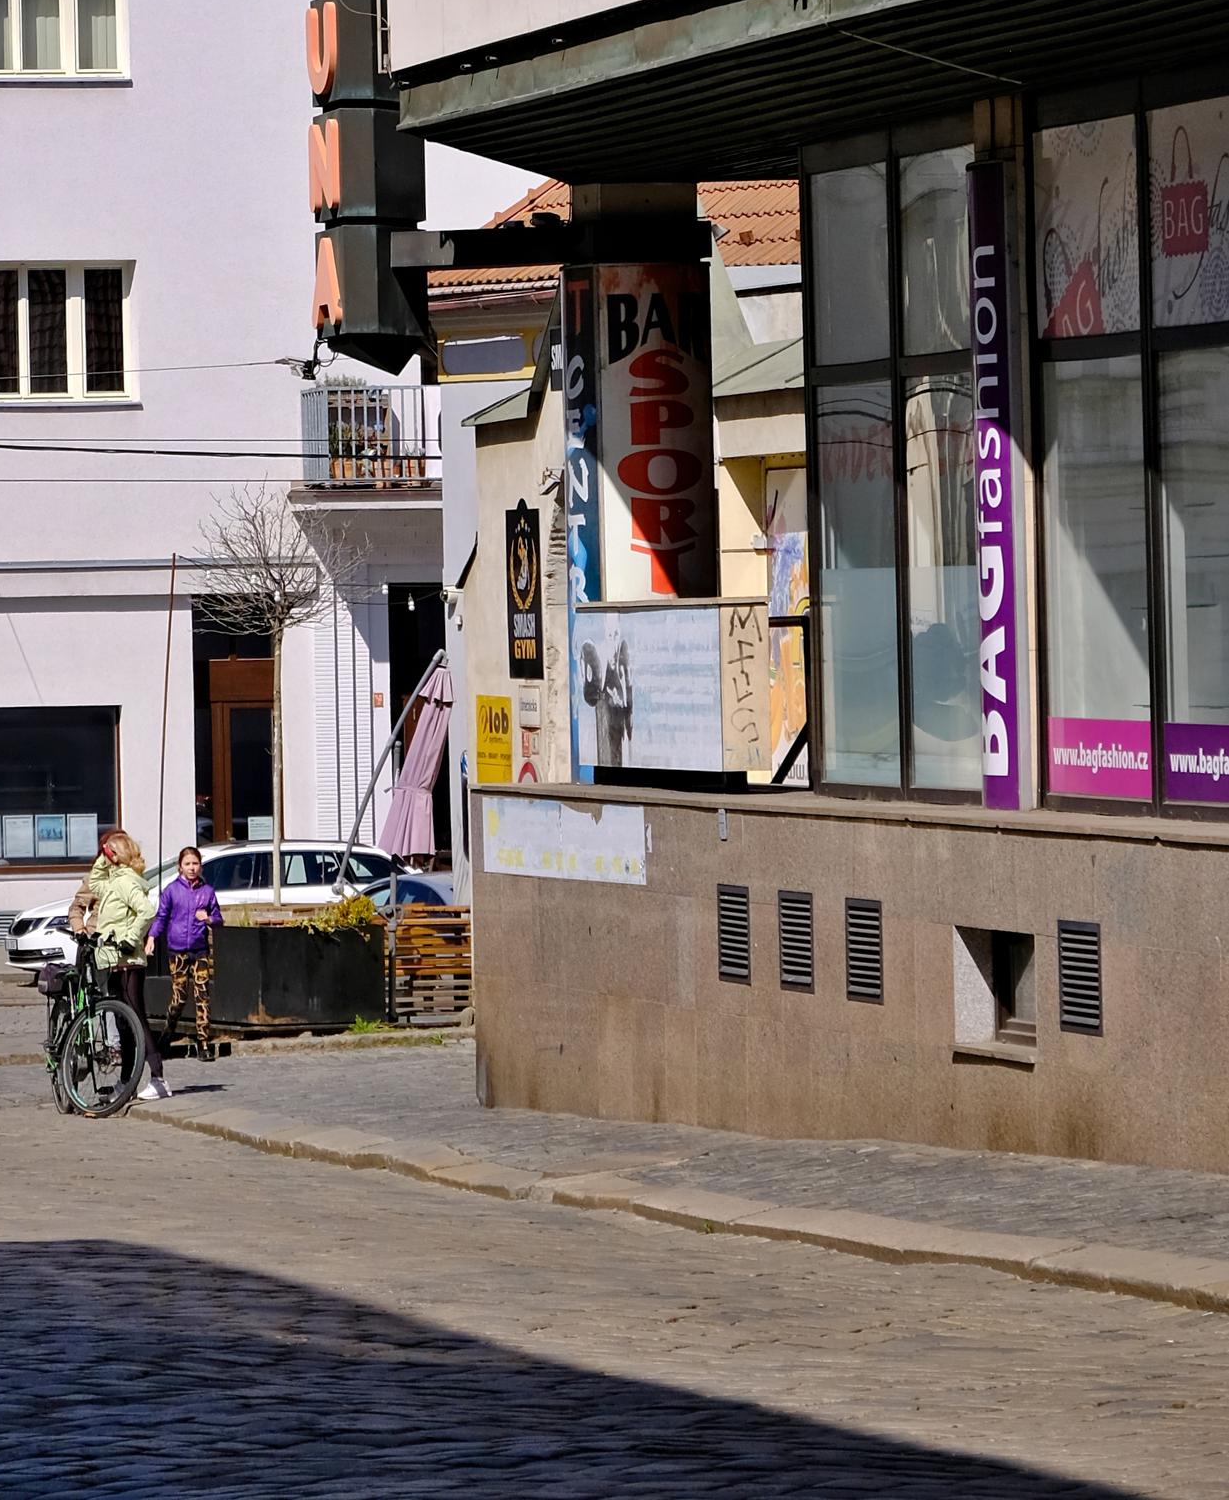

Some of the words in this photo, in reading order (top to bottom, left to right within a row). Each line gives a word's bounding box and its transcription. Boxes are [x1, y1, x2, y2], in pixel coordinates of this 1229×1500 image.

[1163, 195, 1204, 240] BAG
[618, 348, 703, 595] SPORT
[974, 244, 1009, 777] BAGfashion
[513, 612, 536, 639] SMASH
[514, 638, 537, 660] GYM
[1053, 741, 1149, 774] www.bagfashion.cz
